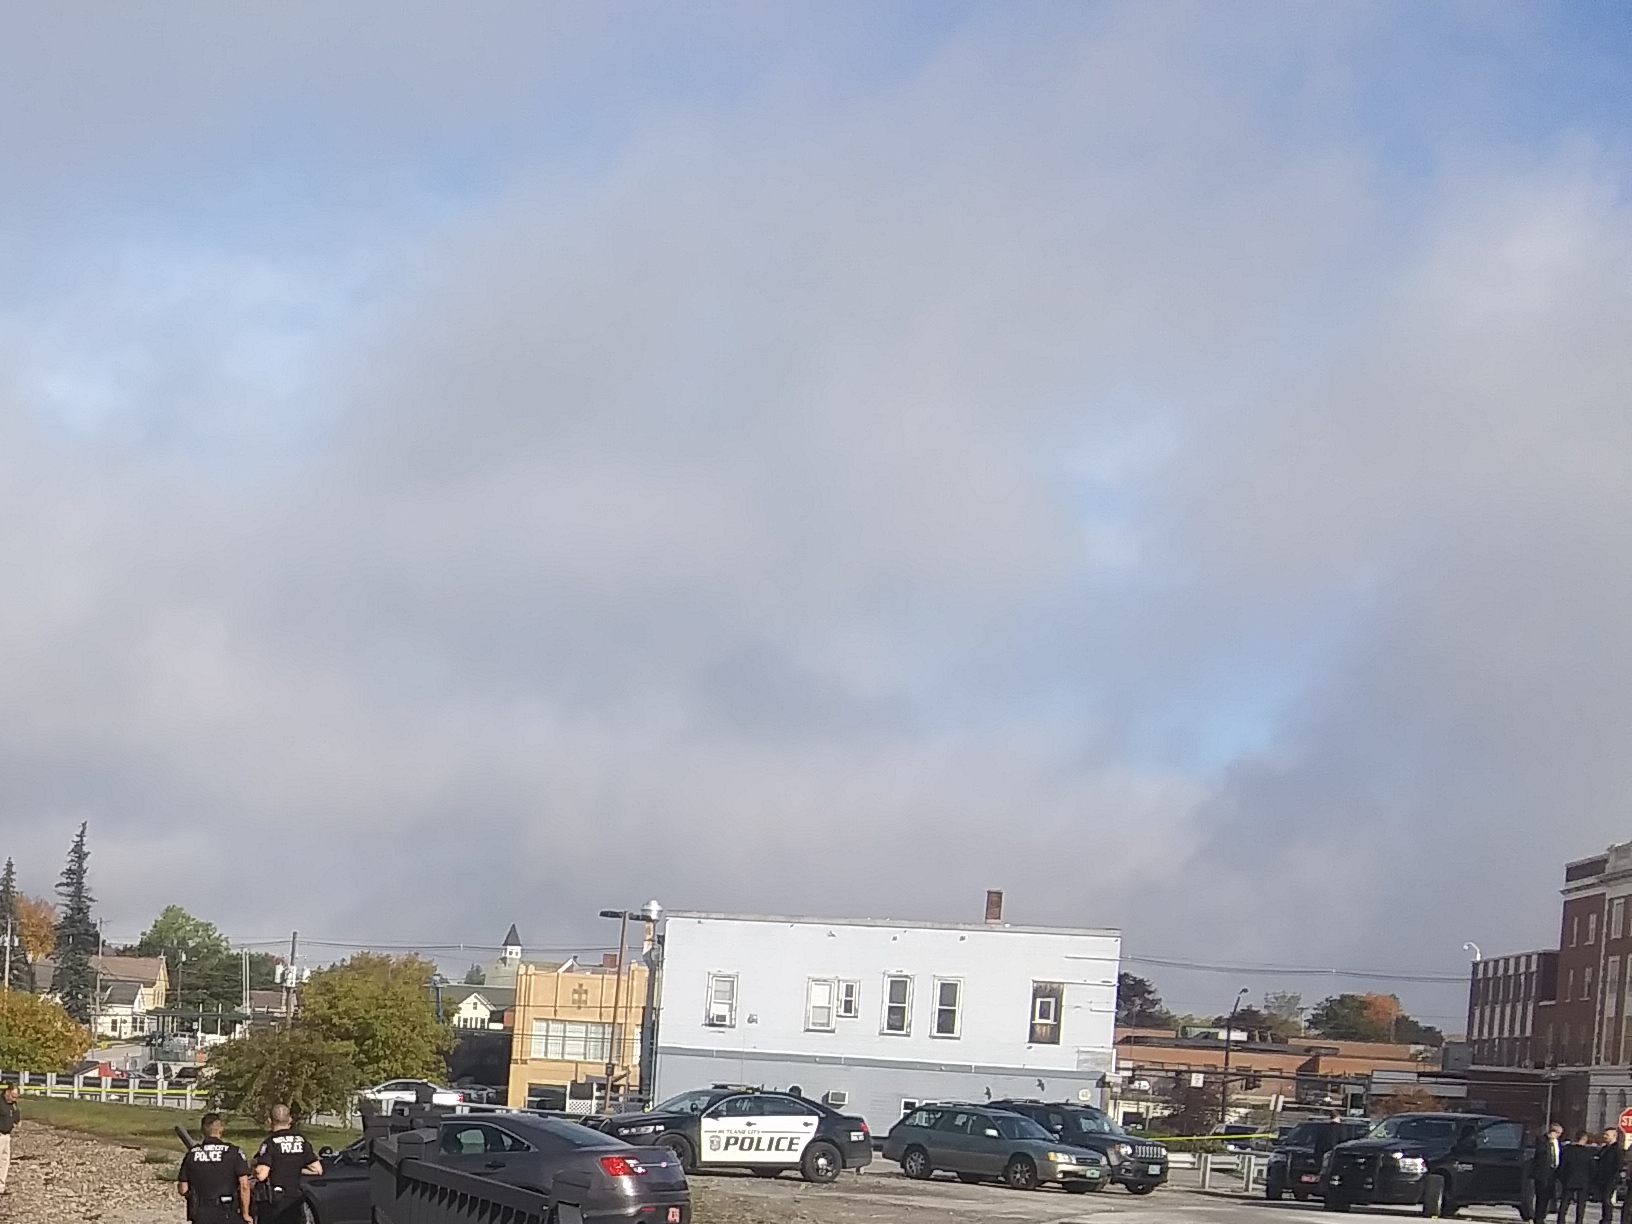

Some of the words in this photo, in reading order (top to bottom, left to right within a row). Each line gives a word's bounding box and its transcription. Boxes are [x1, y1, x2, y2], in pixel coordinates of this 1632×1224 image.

[280, 1142, 304, 1154] POLICE
[723, 1136, 801, 1152] POLICE
[193, 1150, 222, 1161] POLICE
